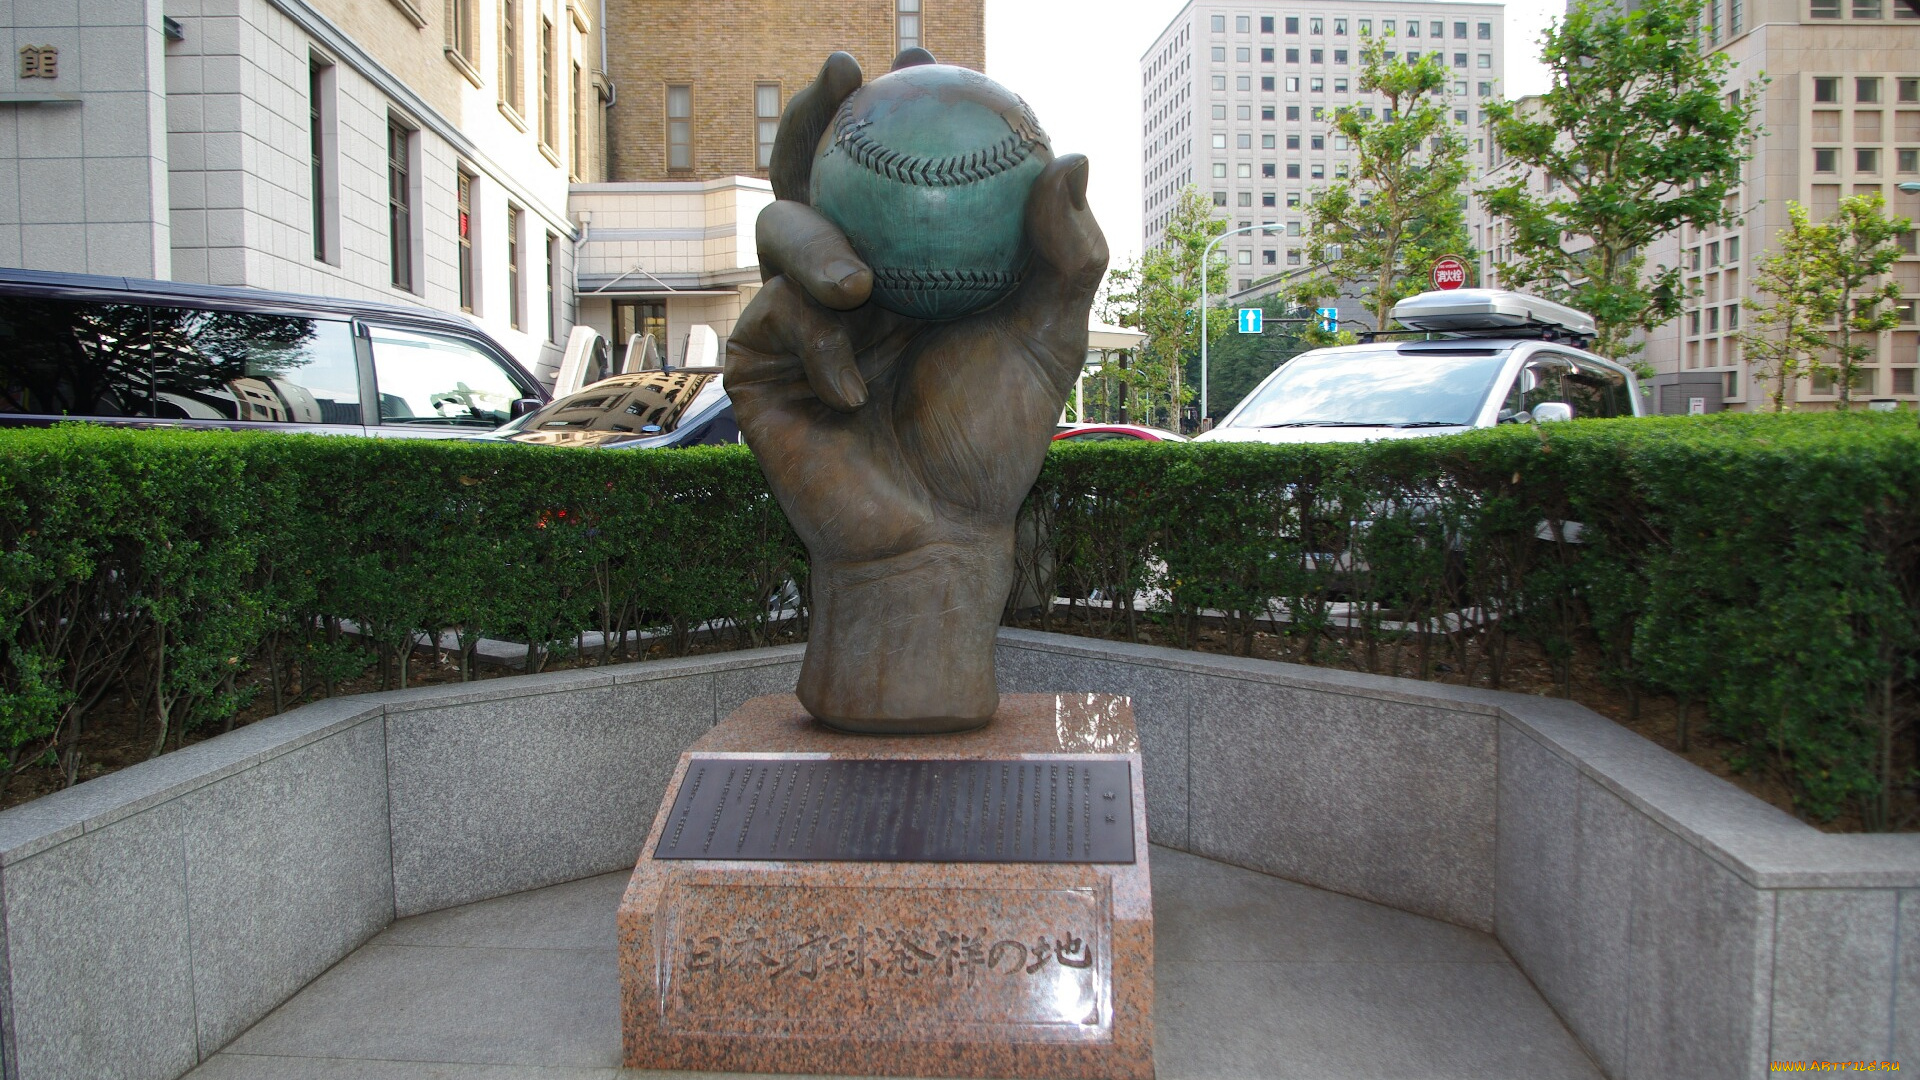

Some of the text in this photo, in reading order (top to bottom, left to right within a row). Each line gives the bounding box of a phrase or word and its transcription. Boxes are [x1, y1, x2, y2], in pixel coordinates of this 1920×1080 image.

[19, 44, 58, 79] 館
[1437, 270, 1462, 282] 消火栓
[684, 925, 1093, 988] 日本野球発祥の地
